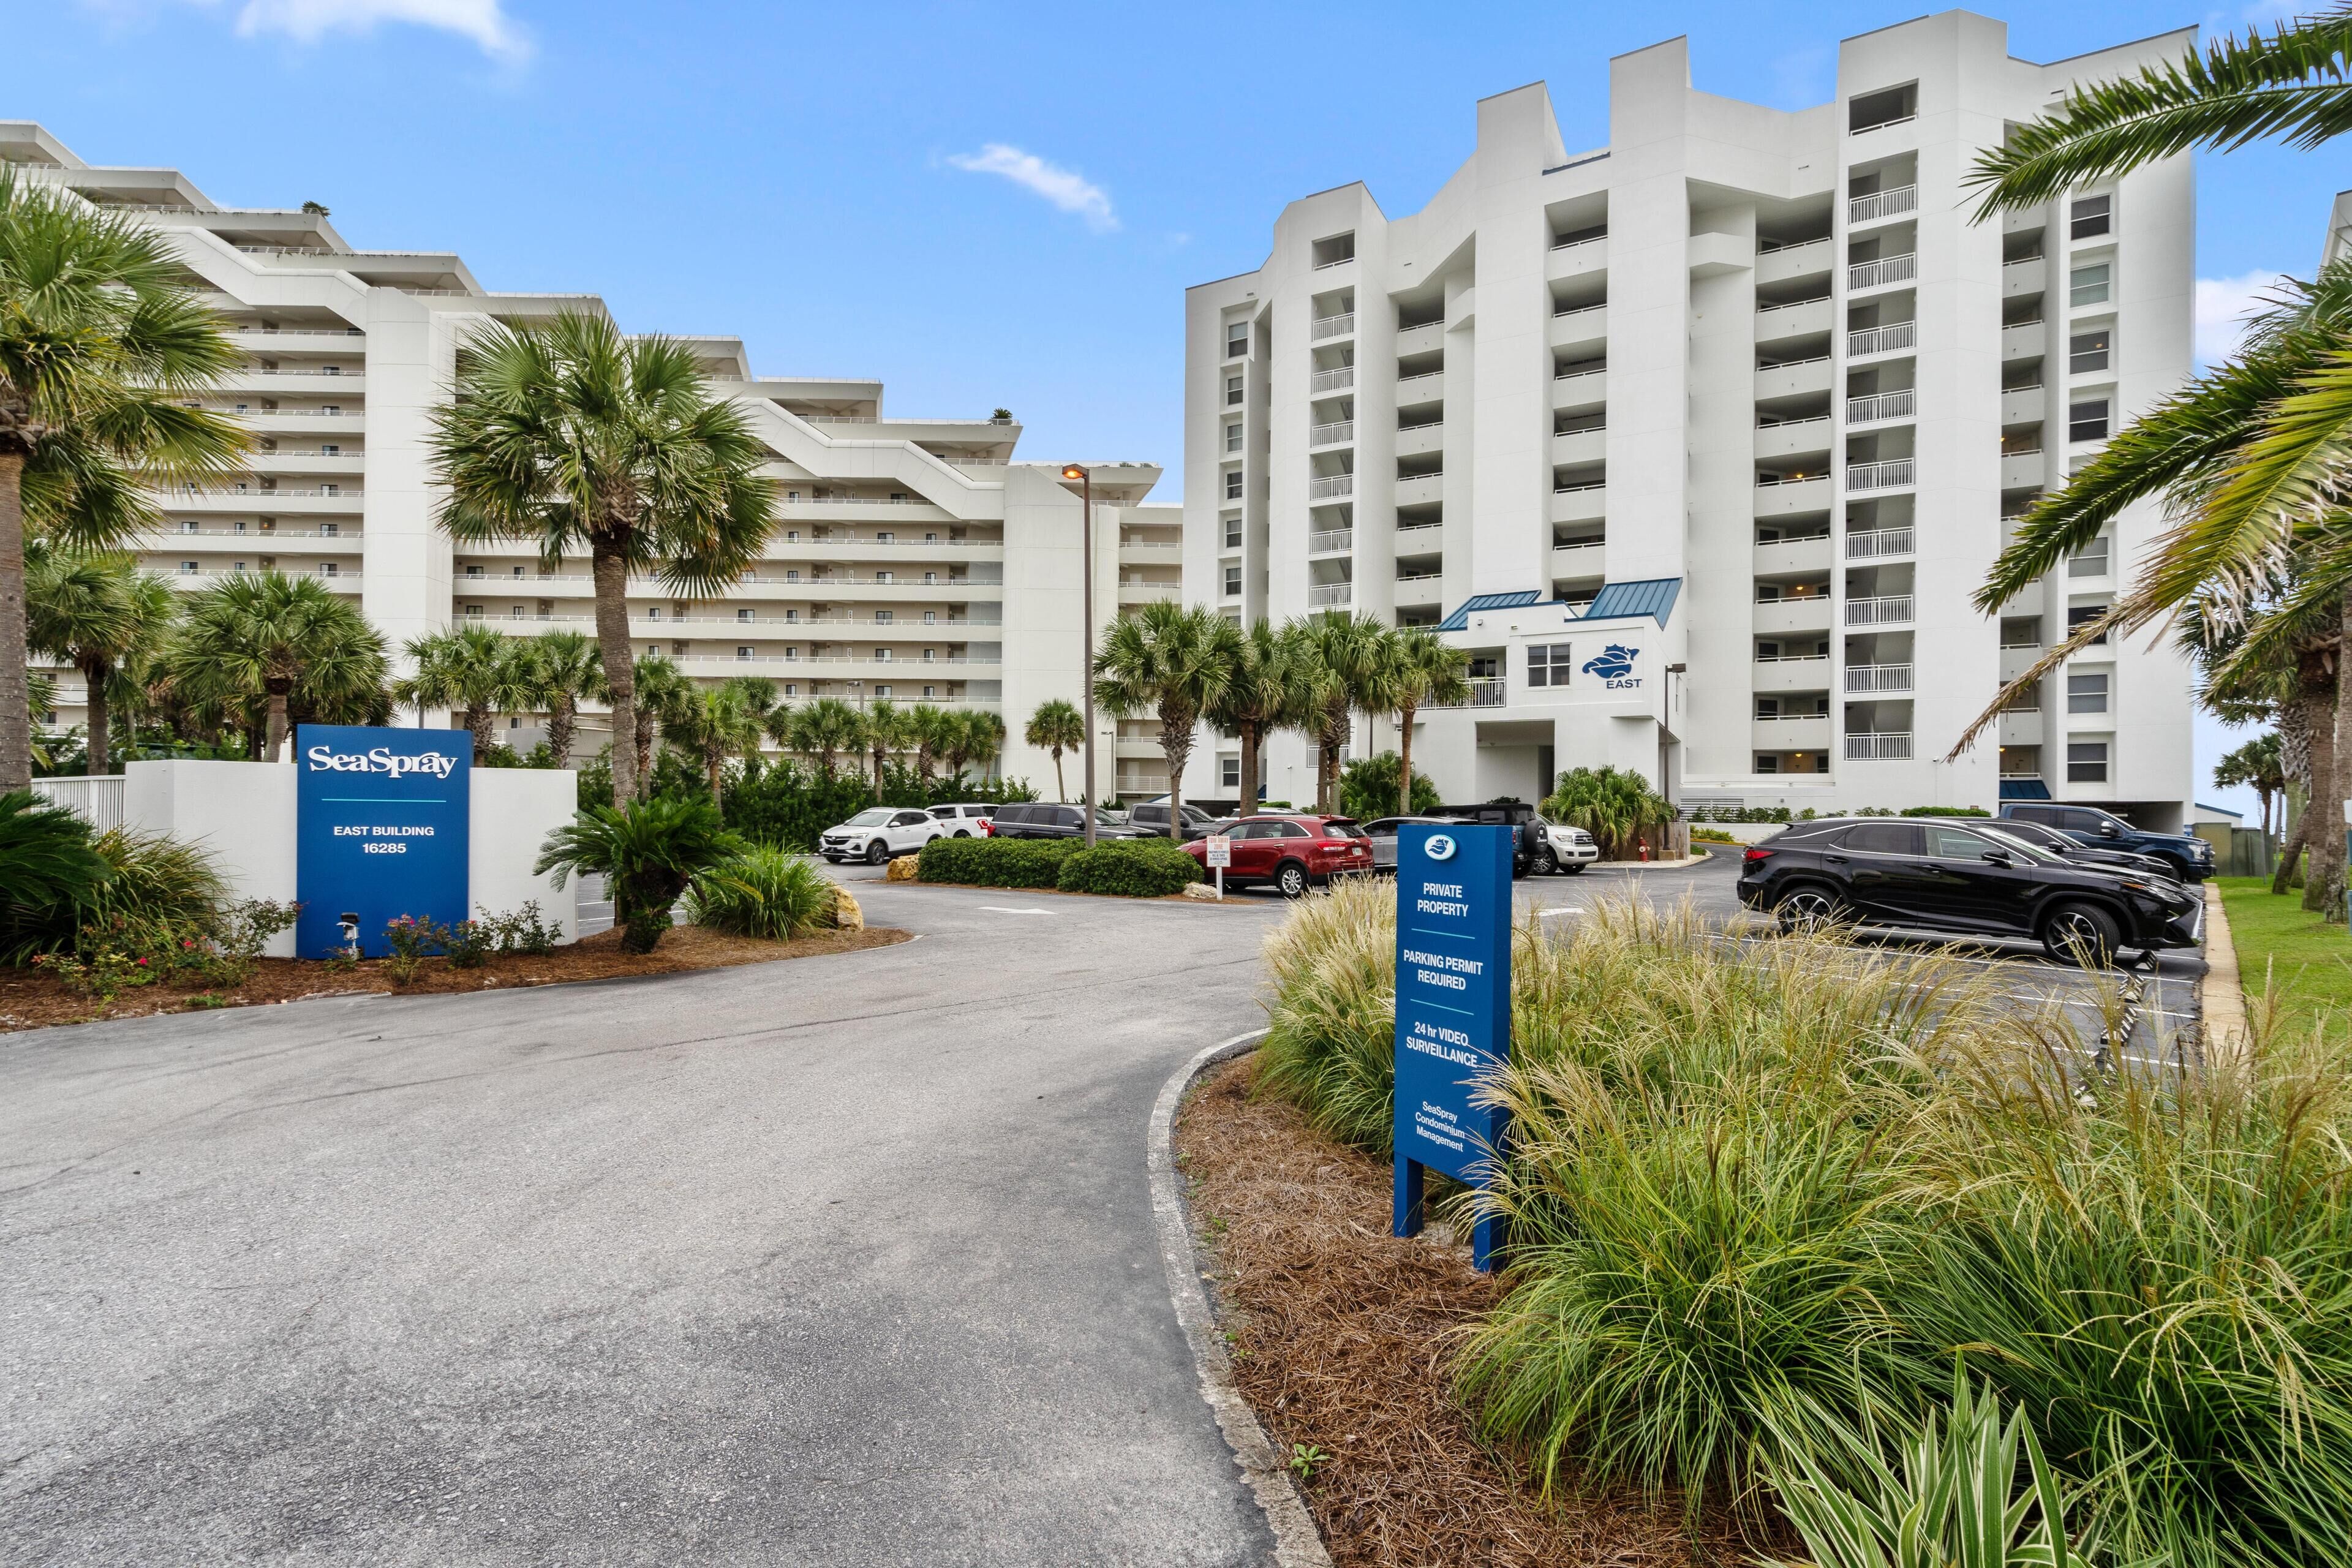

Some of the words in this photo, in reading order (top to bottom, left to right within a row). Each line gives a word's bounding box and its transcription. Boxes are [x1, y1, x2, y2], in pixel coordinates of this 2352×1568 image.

[1607, 679, 1642, 689] EAST
[308, 745, 458, 778] SeaSpray
[334, 826, 369, 836] EAST
[372, 826, 434, 836] BUILDING
[363, 843, 407, 854] 16285
[1423, 882, 1463, 899] PRIVATE
[1417, 899, 1469, 917] PROPERTY
[1403, 949, 1444, 968] PARKING
[1445, 956, 1483, 975] PERMIT
[1417, 969, 1466, 990] REQUIRED
[1414, 1021, 1427, 1035] 24
[1427, 1024, 1437, 1038] hr
[1438, 1027, 1469, 1046] VIDEO
[1406, 1036, 1478, 1068] SURVEILLANCE
[1422, 1101, 1458, 1124] SeaSpray
[1415, 1112, 1465, 1139] Condominium
[1416, 1125, 1463, 1153] Management
